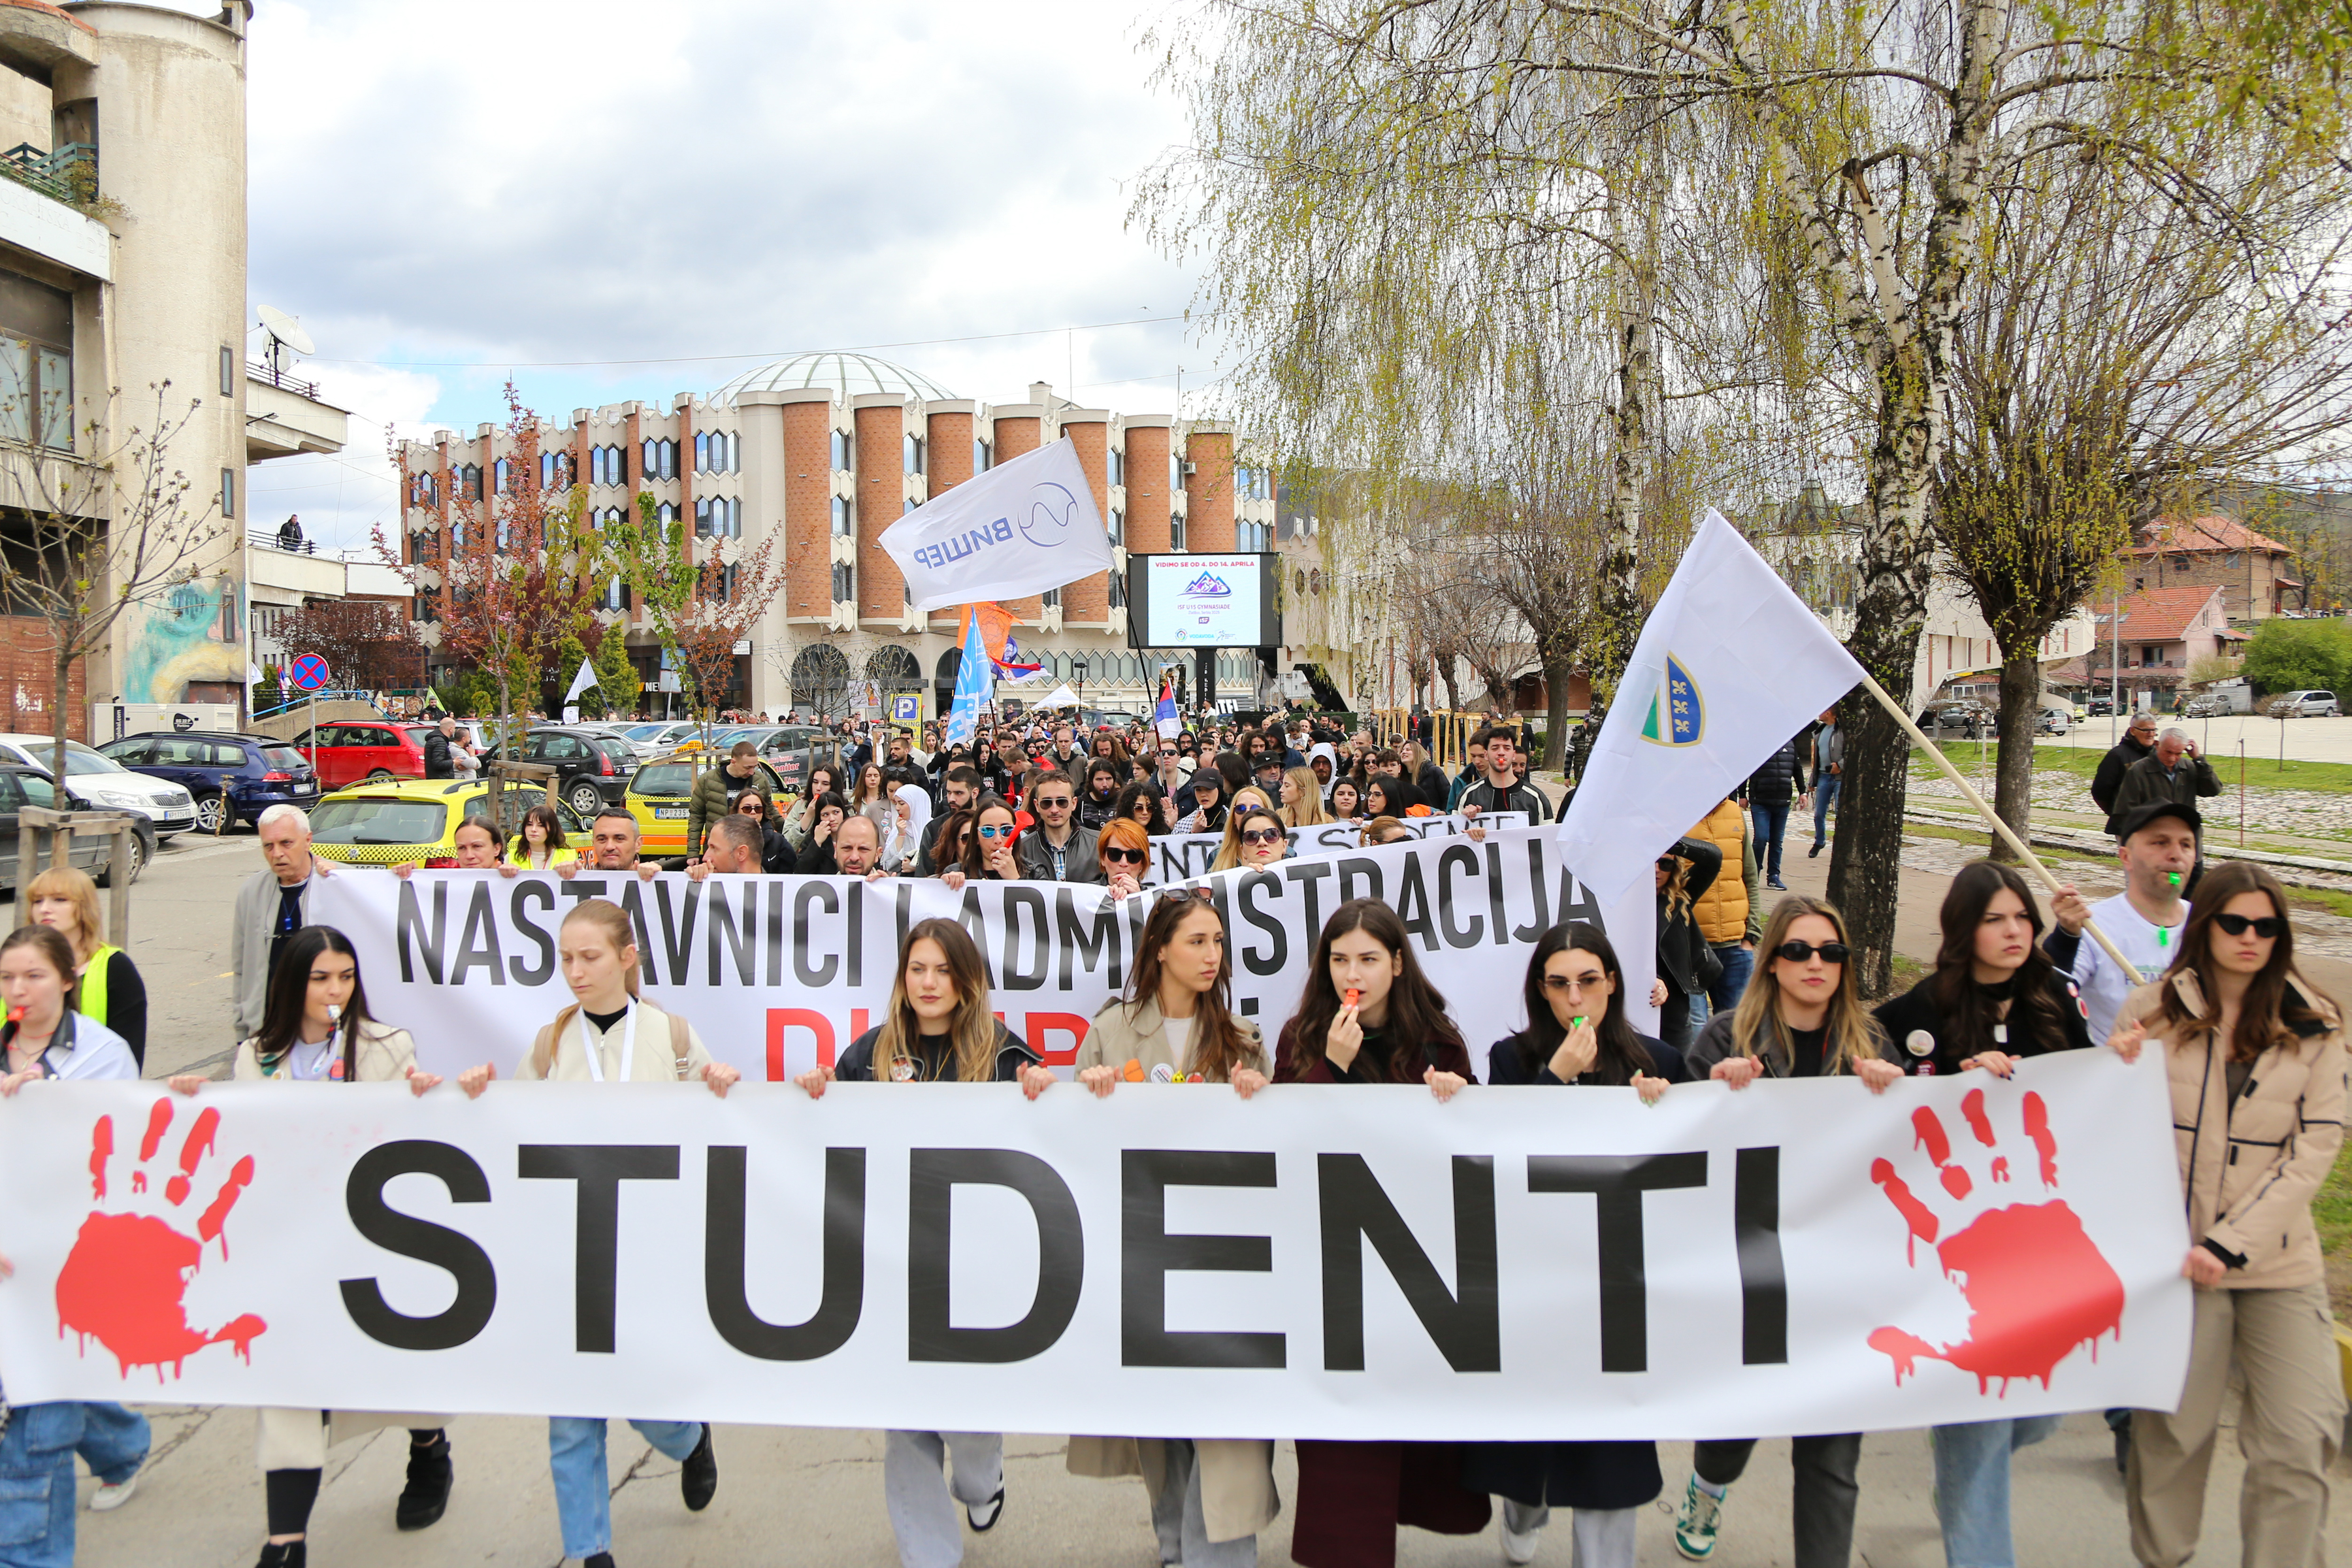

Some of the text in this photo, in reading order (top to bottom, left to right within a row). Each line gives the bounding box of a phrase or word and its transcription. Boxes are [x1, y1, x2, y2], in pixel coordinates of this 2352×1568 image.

[784, 776, 799, 785] Line
[958, 838, 1607, 991] ADMSTACIJA
[339, 1139, 1788, 1375] STUDENTI
